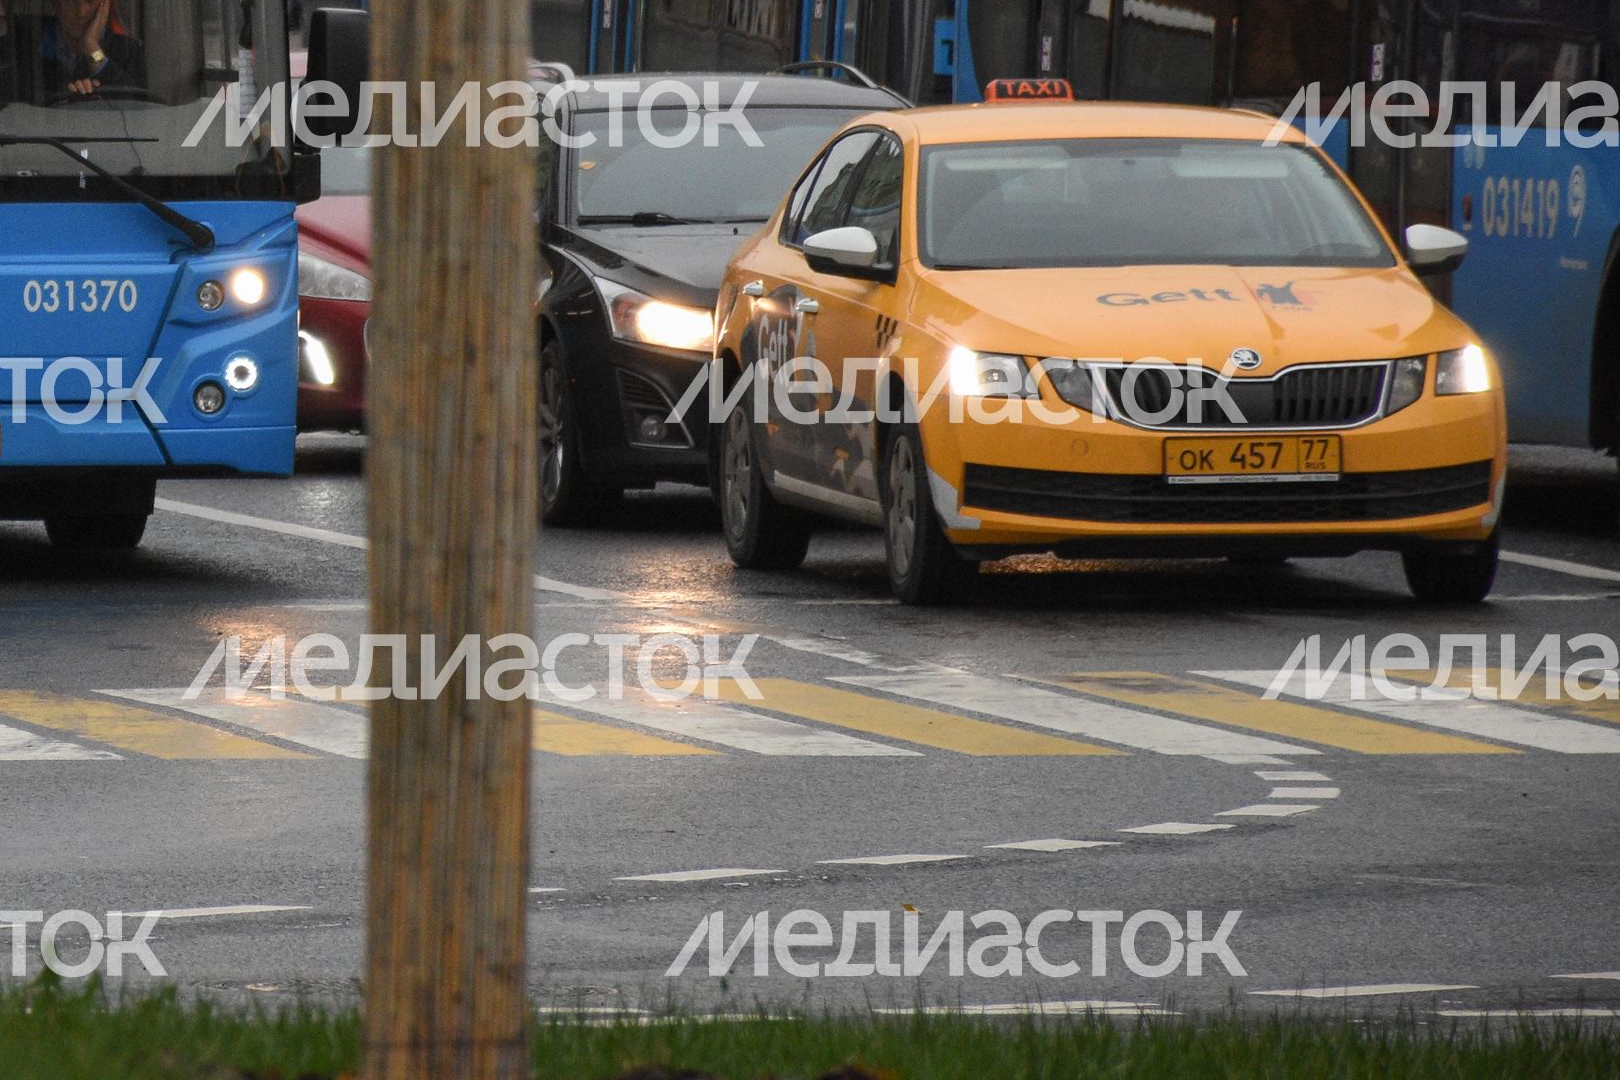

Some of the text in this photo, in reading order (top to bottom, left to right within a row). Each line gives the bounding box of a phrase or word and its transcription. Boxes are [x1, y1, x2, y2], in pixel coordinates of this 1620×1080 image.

[1001, 81, 1062, 96] TAXI
[1482, 176, 1559, 239] 031419
[23, 279, 137, 314] 031370
[1096, 287, 1242, 307] Gett
[1229, 442, 1283, 470] 457
[1302, 439, 1329, 461] 77
